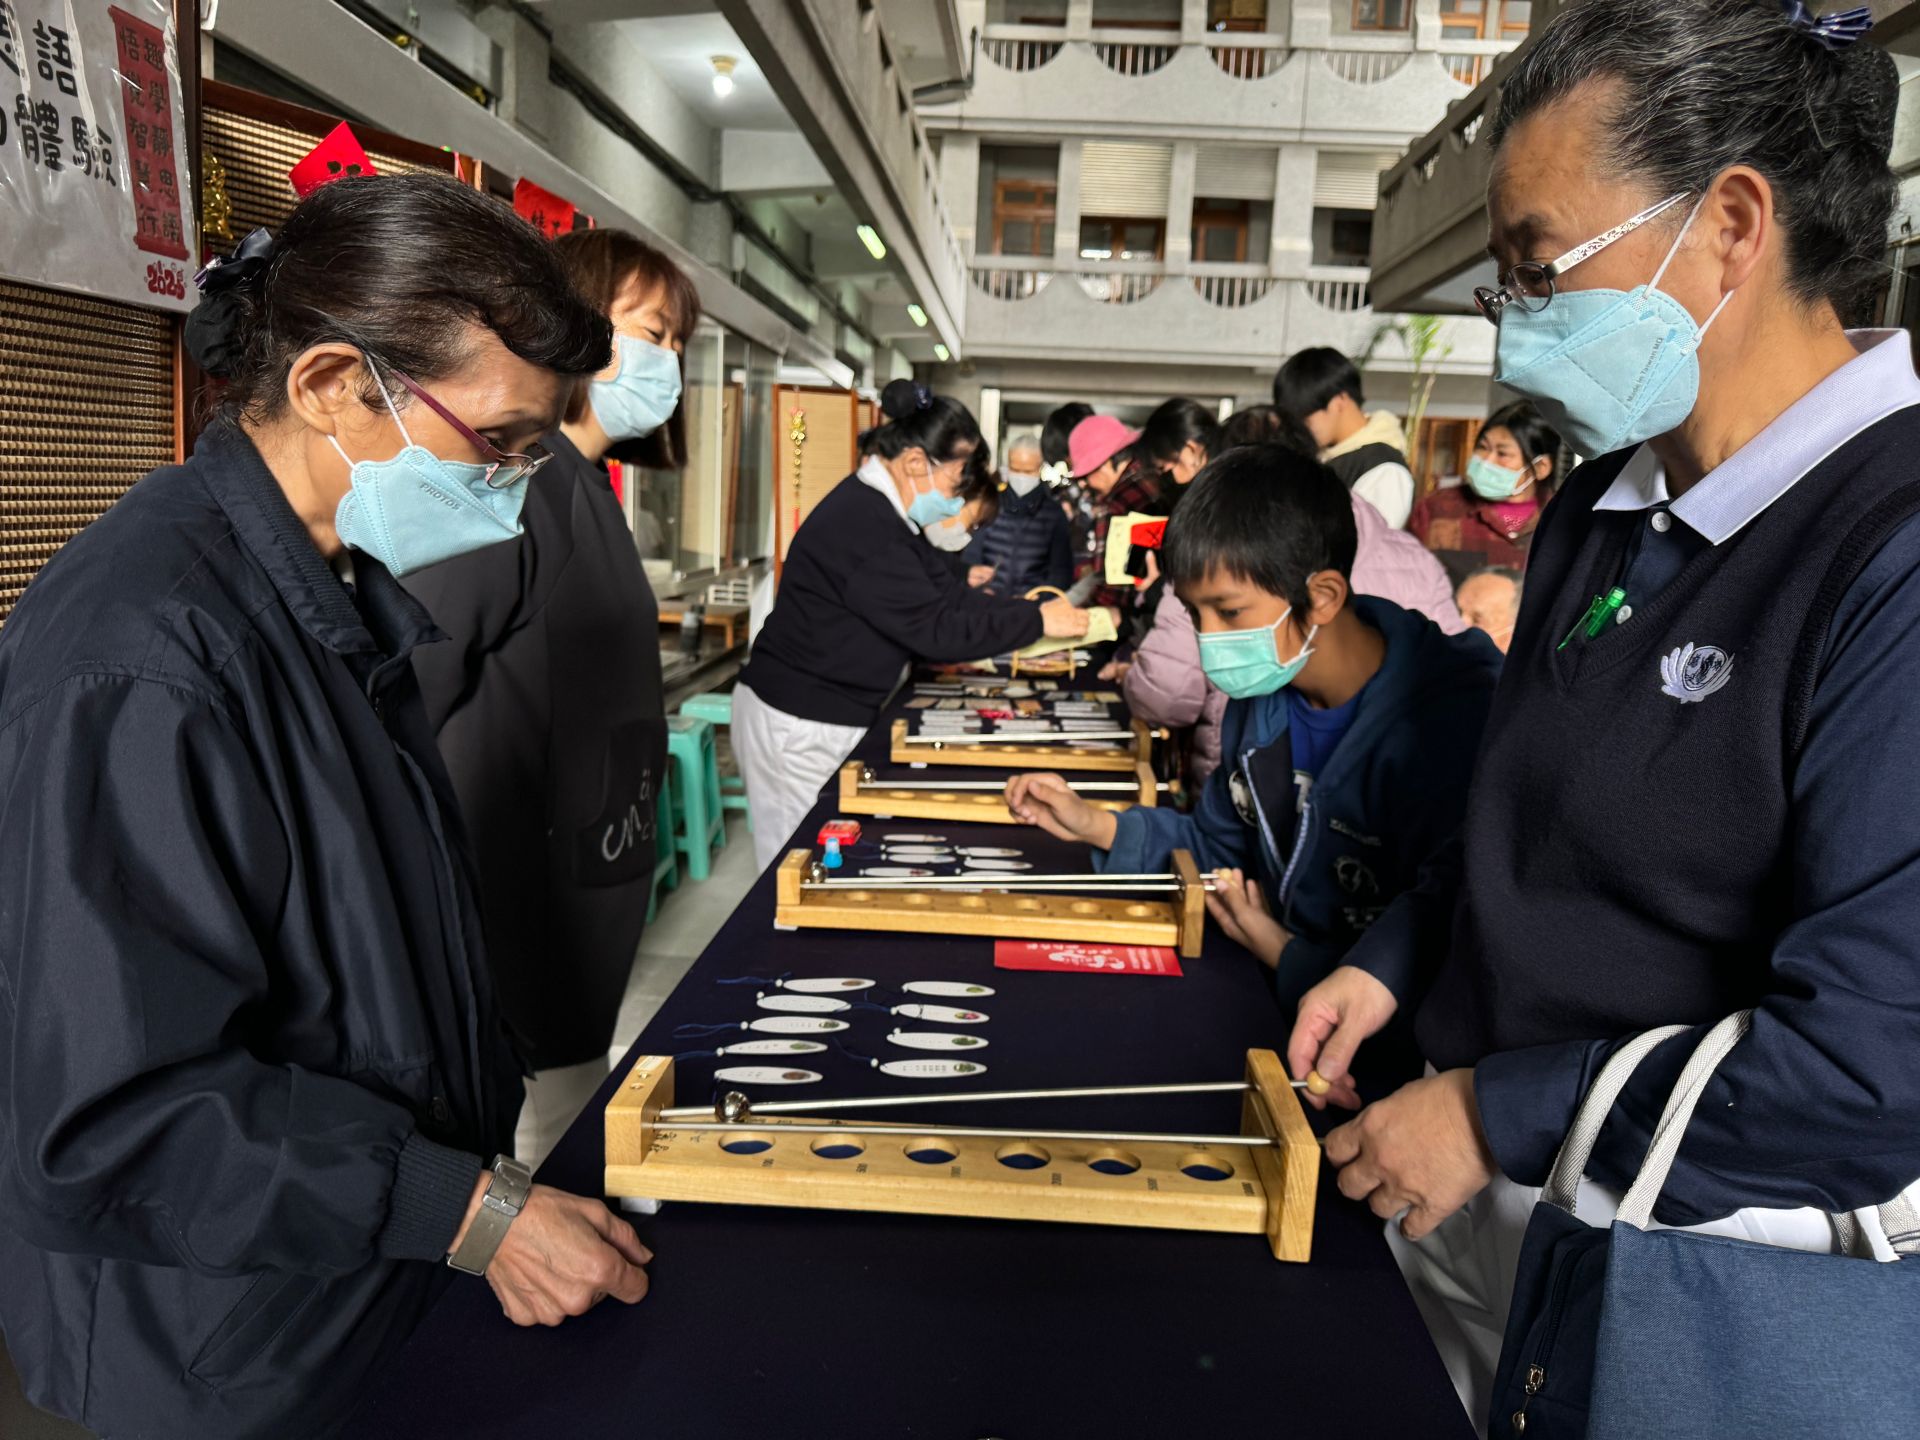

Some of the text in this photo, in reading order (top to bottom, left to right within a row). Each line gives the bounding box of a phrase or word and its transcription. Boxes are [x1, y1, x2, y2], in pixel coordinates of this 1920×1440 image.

[0, 93, 116, 187] 體驗
[1640, 350, 1657, 375] Taiwan
[419, 482, 462, 512] PROTOS
